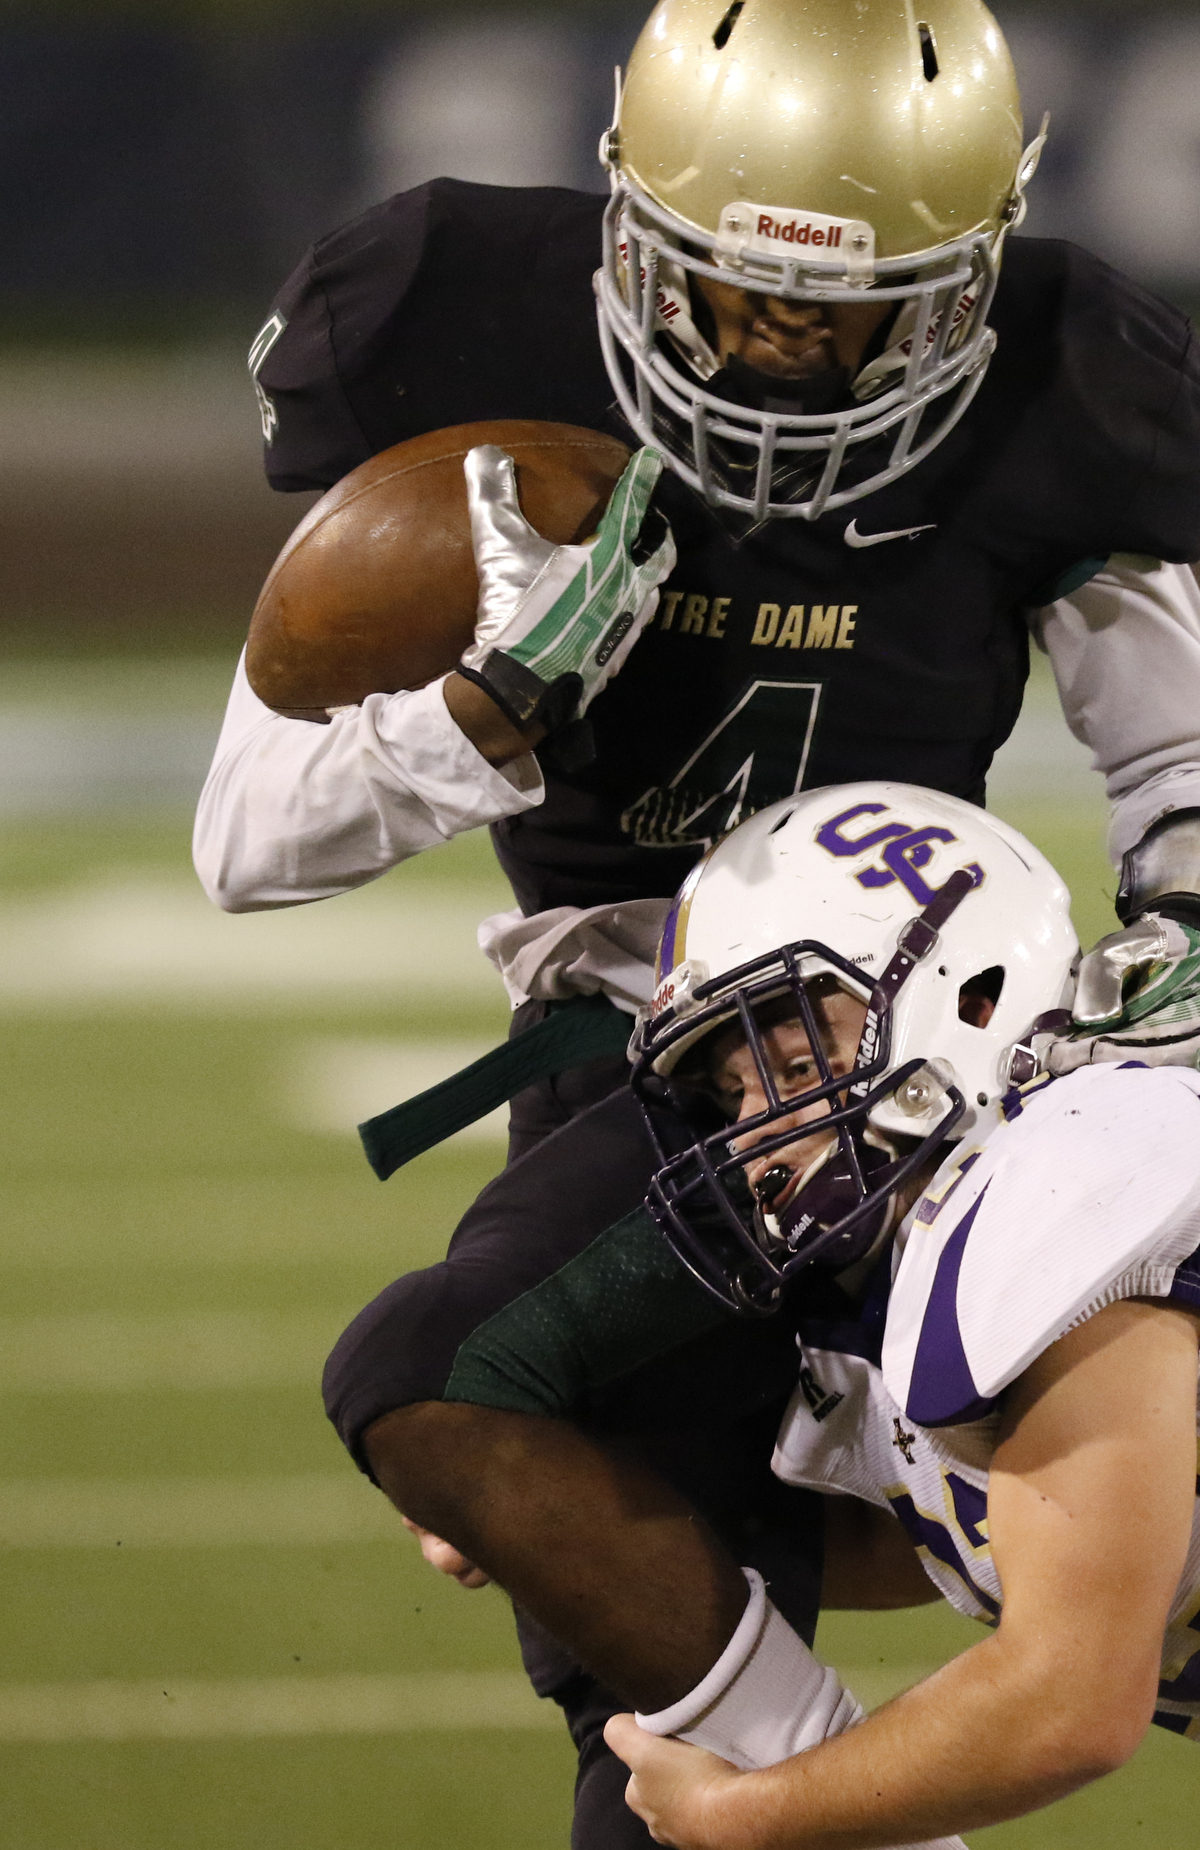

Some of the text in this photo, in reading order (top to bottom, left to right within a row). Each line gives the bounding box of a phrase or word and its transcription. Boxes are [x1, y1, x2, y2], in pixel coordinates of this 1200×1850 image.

[757, 213, 842, 247] Riddell
[649, 591, 859, 650] TRE DAME
[850, 953, 875, 965] ddell
[849, 1008, 878, 1098] Rddell
